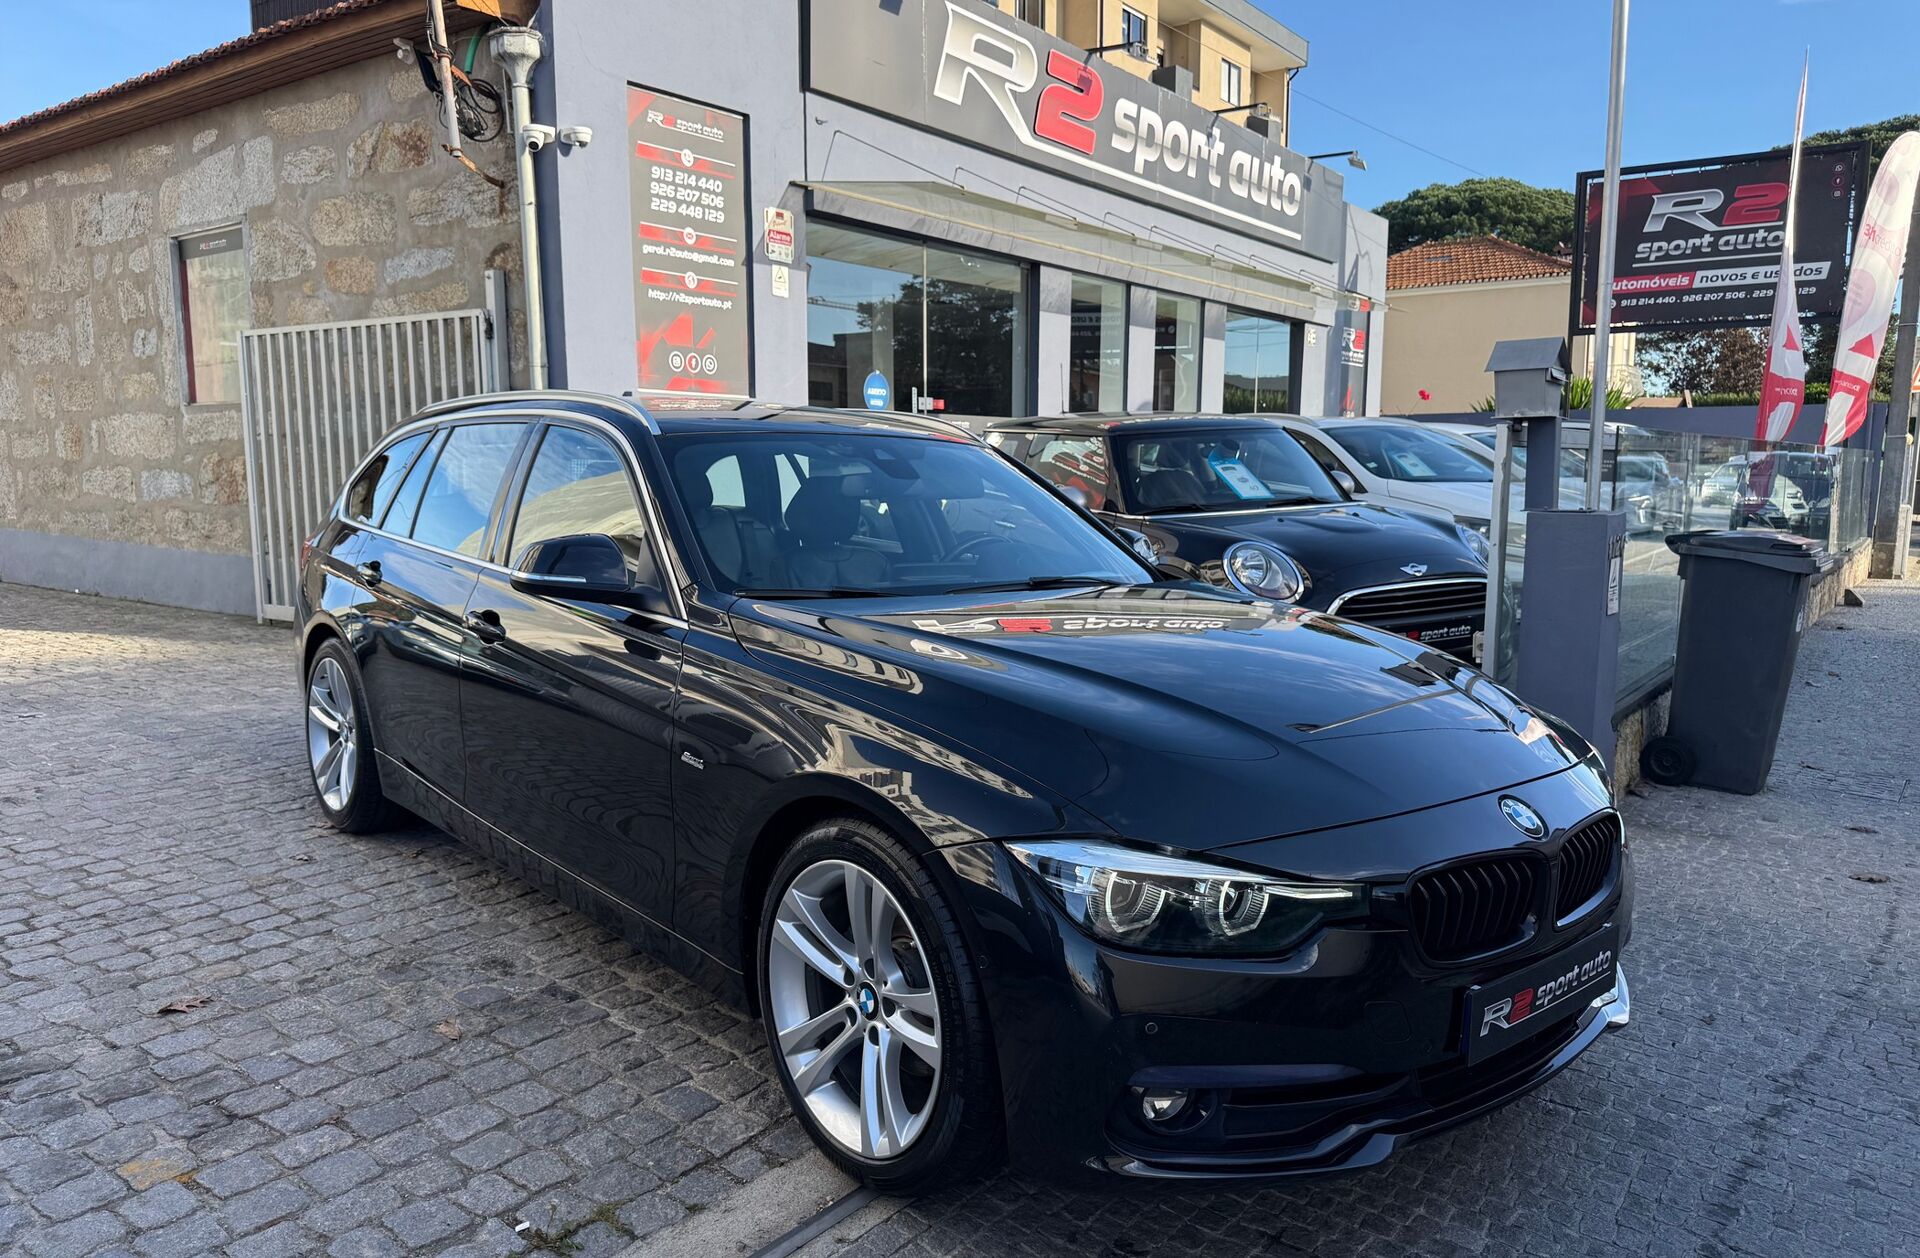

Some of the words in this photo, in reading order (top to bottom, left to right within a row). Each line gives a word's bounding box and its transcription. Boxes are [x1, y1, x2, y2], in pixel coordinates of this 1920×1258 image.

[933, 0, 1104, 156] R2
[1111, 97, 1225, 189] sport
[1228, 149, 1301, 217] auto
[676, 119, 703, 134] sport
[703, 126, 724, 139] auto
[651, 166, 673, 182] 913
[675, 172, 696, 187] 214
[698, 177, 723, 193] 440
[650, 181, 675, 198] 926
[676, 187, 700, 202] 207
[701, 193, 724, 208] 506
[1642, 182, 1788, 233] R2
[651, 197, 677, 213] 229
[678, 203, 703, 219] 448
[704, 208, 725, 223] 129
[1635, 233, 1714, 262] sport
[1718, 228, 1785, 250] auto
[1612, 274, 1690, 290] utomóveis
[1700, 271, 1747, 284] novos
[1764, 266, 1823, 279] usdos
[1621, 299, 1637, 307] 913
[1638, 297, 1655, 306] 214
[1656, 296, 1675, 304] 440
[1682, 294, 1702, 302] 926
[1704, 292, 1724, 301] 207
[1725, 291, 1746, 300] 506
[1752, 289, 1774, 298] 229
[1798, 286, 1817, 295] 129
[1341, 327, 1365, 351] R2
[1420, 627, 1448, 640] sport
[1449, 625, 1471, 636] auto
[1480, 988, 1534, 1037] R2
[1536, 965, 1579, 1006] sport
[1580, 950, 1612, 980] auto
